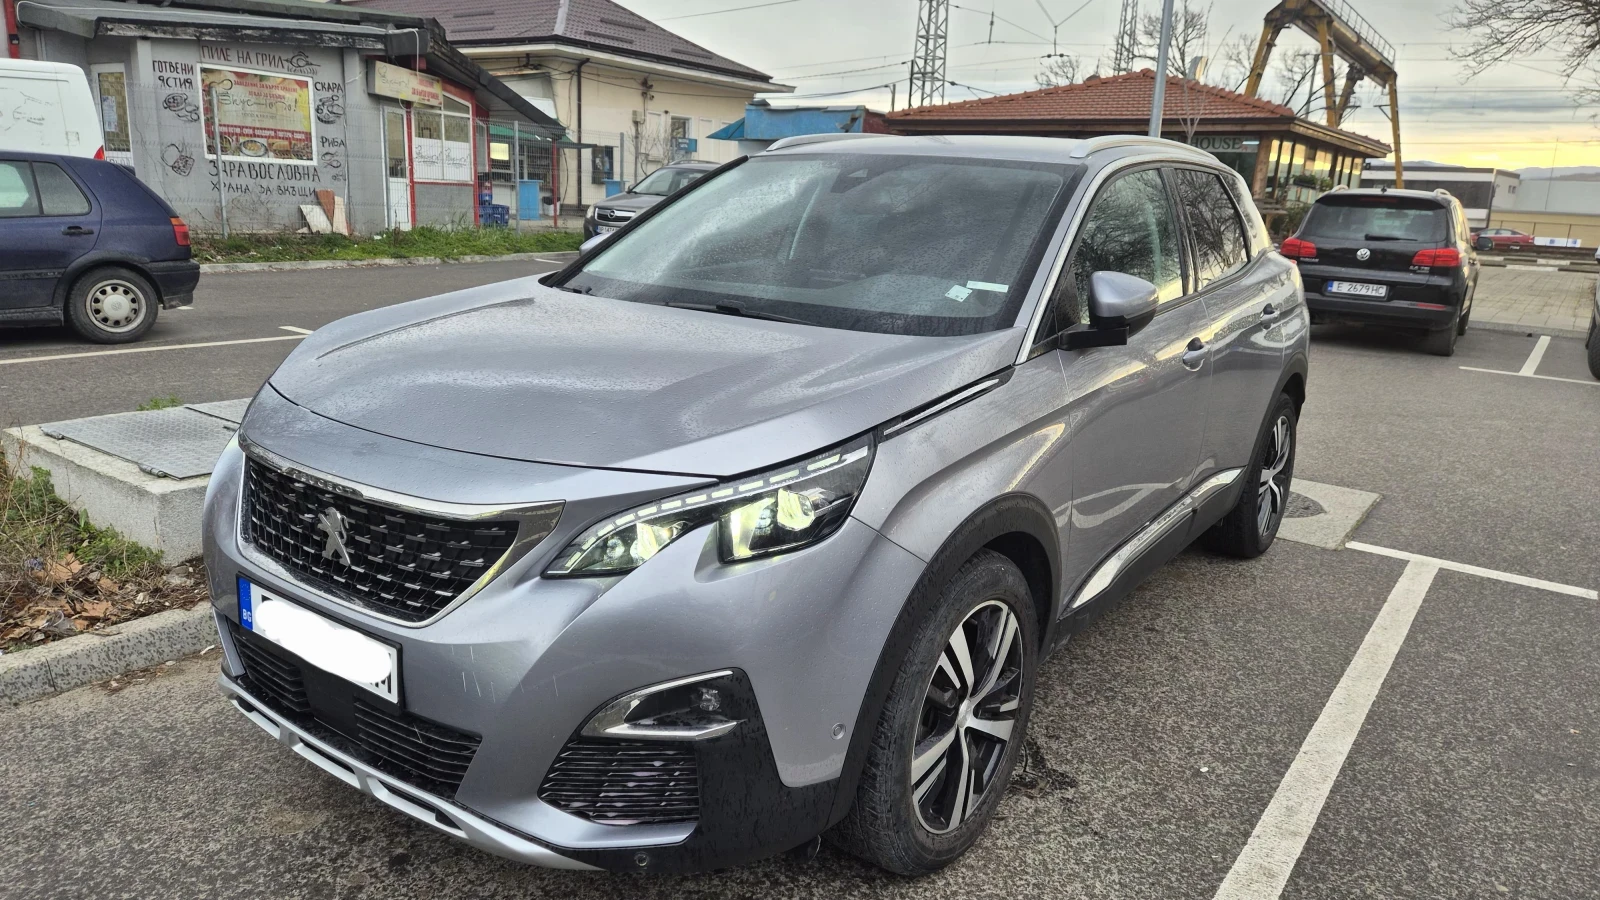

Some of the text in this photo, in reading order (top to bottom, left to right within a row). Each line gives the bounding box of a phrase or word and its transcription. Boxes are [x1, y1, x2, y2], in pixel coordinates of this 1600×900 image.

[201, 45, 284, 69] ПИЛЕ НА ГРИЛ
[152, 60, 194, 76] ГОТВЕНИ
[158, 75, 193, 90] ЯСТИЯ
[314, 81, 343, 93] СКАРА
[320, 136, 345, 148] РИБА
[208, 160, 321, 182] ЗДРАВОСЛОВНА
[259, 184, 272, 196] ЗА
[277, 185, 317, 197] ВКЪЩИ
[1336, 282, 1384, 296] E 2679 HC
[242, 608, 252, 624] BG
